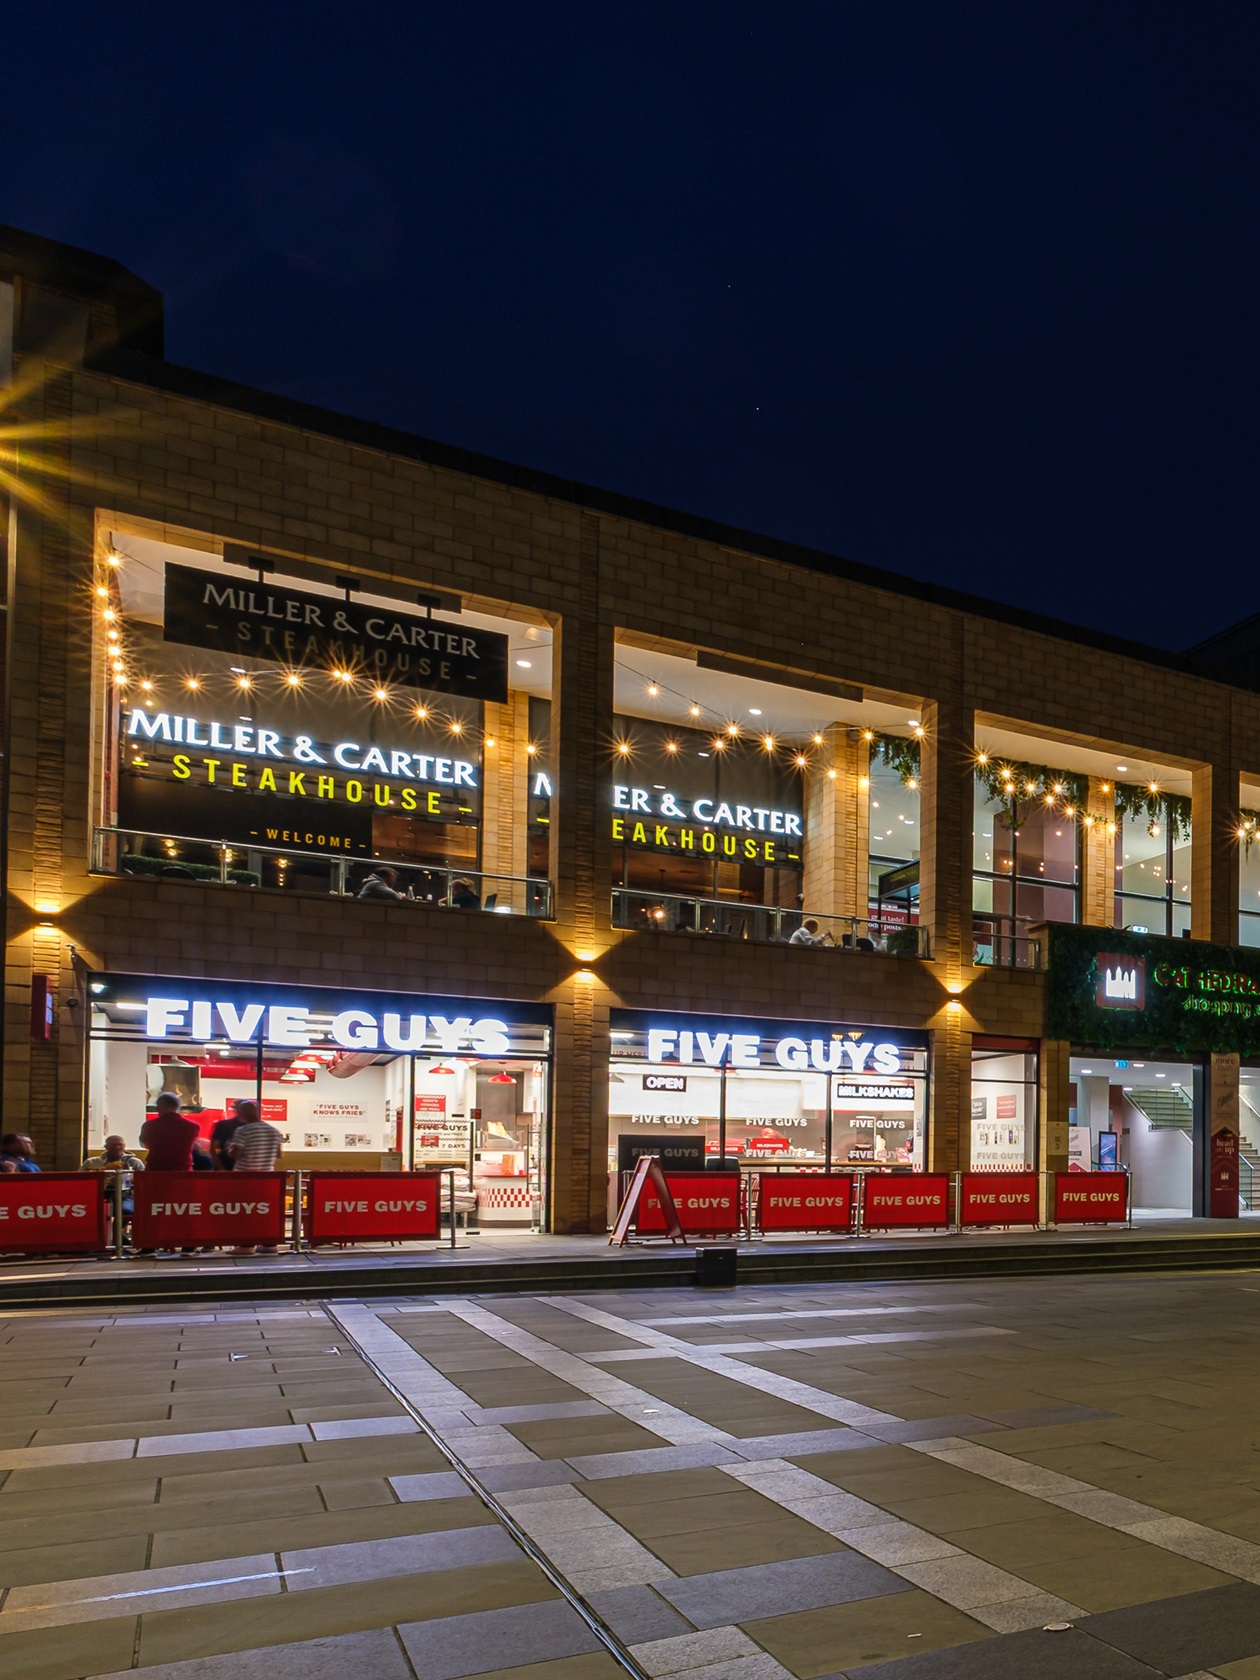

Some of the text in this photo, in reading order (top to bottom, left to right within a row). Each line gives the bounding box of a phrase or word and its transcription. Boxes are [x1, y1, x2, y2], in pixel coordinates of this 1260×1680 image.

[202, 583, 482, 660] MILLER & CARTER
[237, 620, 451, 681] STEAKHOUSE
[126, 708, 478, 787] MILLER & CARTER
[172, 753, 441, 816] STEAKHOUSE
[660, 793, 687, 818] &
[693, 799, 803, 837] CARTER
[266, 828, 352, 850] WELCOME
[1182, 994, 1251, 1020] shopping
[146, 998, 511, 1055] FIVE GUYS
[648, 1029, 901, 1075] FIVE GUYS
[645, 1076, 685, 1090] OPEN
[838, 1085, 914, 1099] MILKSHAKES
[631, 1114, 700, 1125] FIVE GUYS
[746, 1117, 808, 1127] FIVE GUYS
[849, 1120, 906, 1129] FIVE GUYS
[977, 1123, 1026, 1132] FIVE GUYS
[1216, 1138, 1234, 1147] head
[632, 1148, 700, 1158] FIVE GUYS
[746, 1149, 773, 1158] FIVE
[849, 1150, 874, 1159] FIVE
[977, 1152, 998, 1160] FIVE
[647, 1197, 730, 1209] FIE GUYS
[770, 1196, 844, 1208] FIVE GUYS
[873, 1195, 941, 1206] FIVE GUYS
[969, 1194, 1030, 1204] FIVE GUYS
[1062, 1192, 1120, 1202] FIVE GUYS
[17, 1204, 87, 1220] GUYS
[151, 1202, 270, 1216] FIVE GUYS
[324, 1199, 428, 1214] FIVE GUYS
